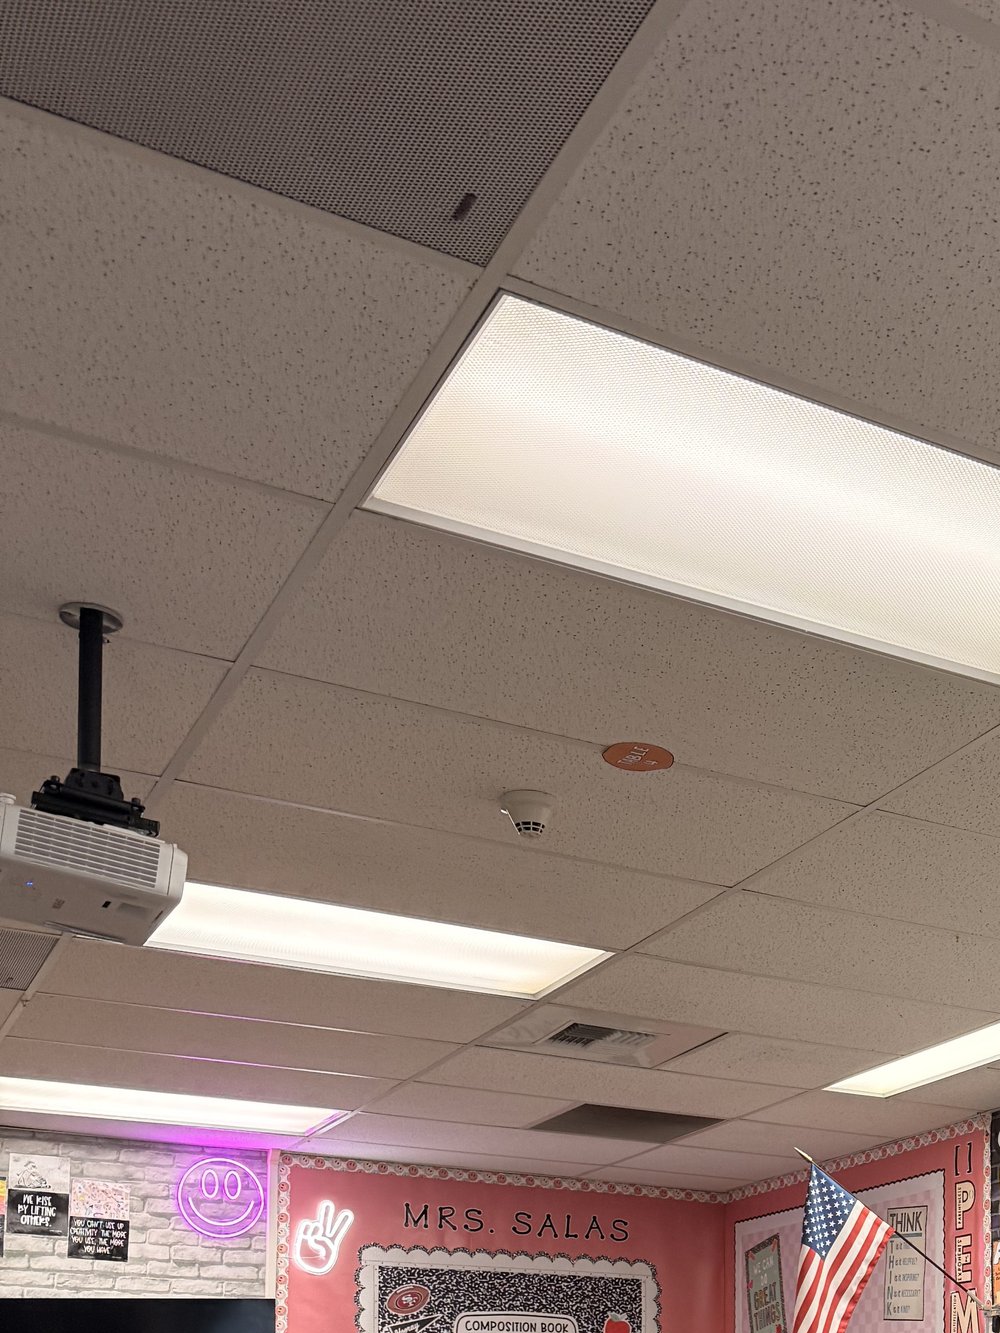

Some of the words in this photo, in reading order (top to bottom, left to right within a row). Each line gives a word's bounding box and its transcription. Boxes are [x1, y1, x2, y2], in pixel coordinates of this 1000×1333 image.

[17, 1204, 29, 1214] BY
[31, 1205, 56, 1217] LIFTING
[403, 1202, 495, 1234] MRS.
[512, 1211, 630, 1242] SALAS
[890, 1211, 923, 1233] THINK
[754, 1282, 777, 1310] GREAT
[465, 1319, 537, 1333] COMPOSITION
[540, 1321, 569, 1333] BOOK
[754, 1301, 781, 1331] THINGS
